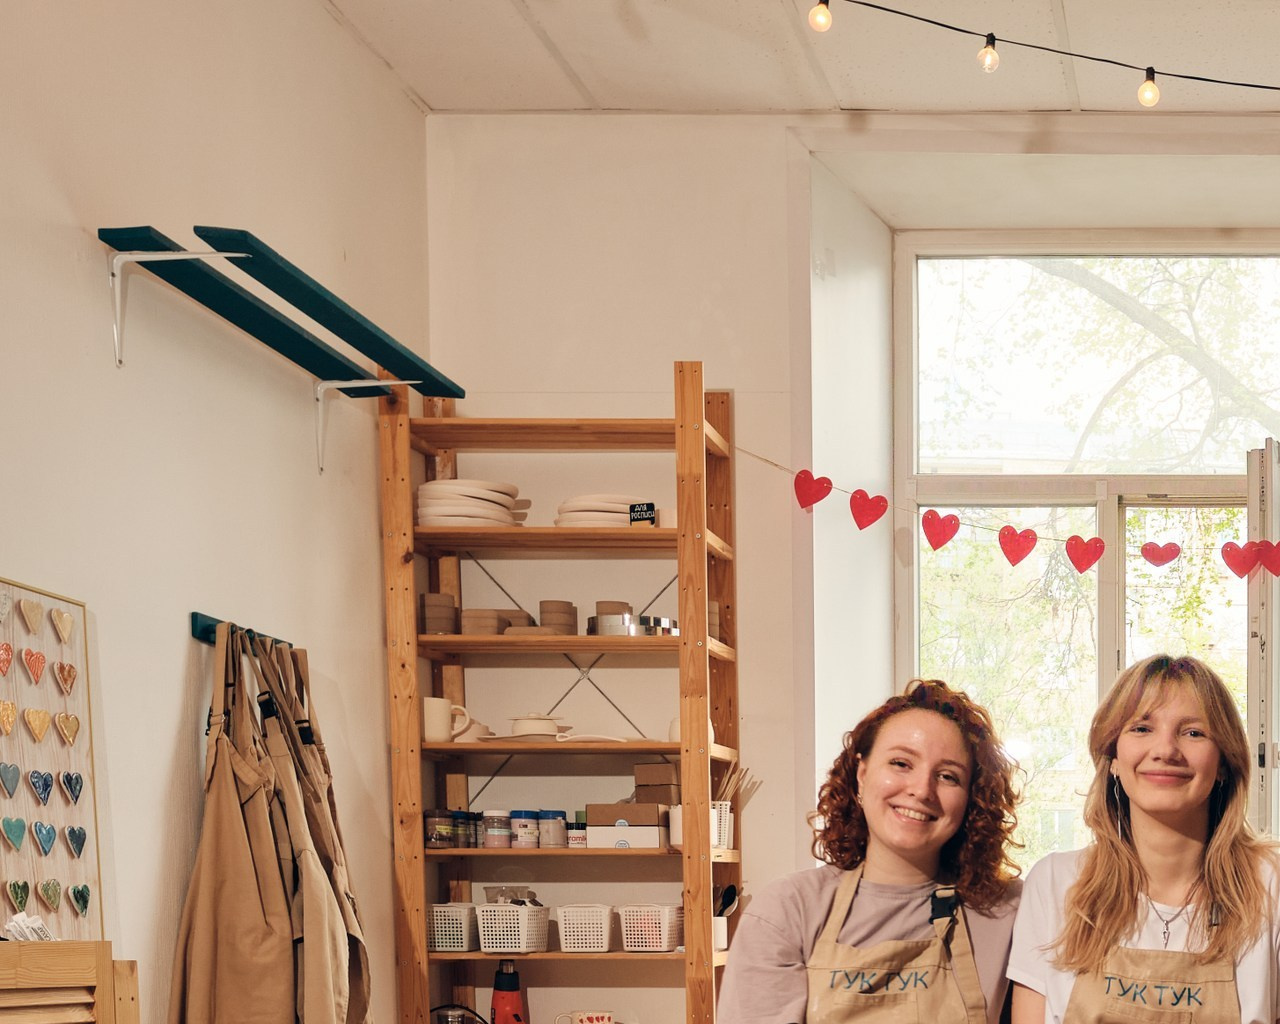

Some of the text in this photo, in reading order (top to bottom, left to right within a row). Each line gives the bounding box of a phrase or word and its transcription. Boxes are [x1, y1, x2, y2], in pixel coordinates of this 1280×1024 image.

[830, 970, 929, 991] ТУК ТУК
[1104, 976, 1203, 1006] ТУК ТУК
